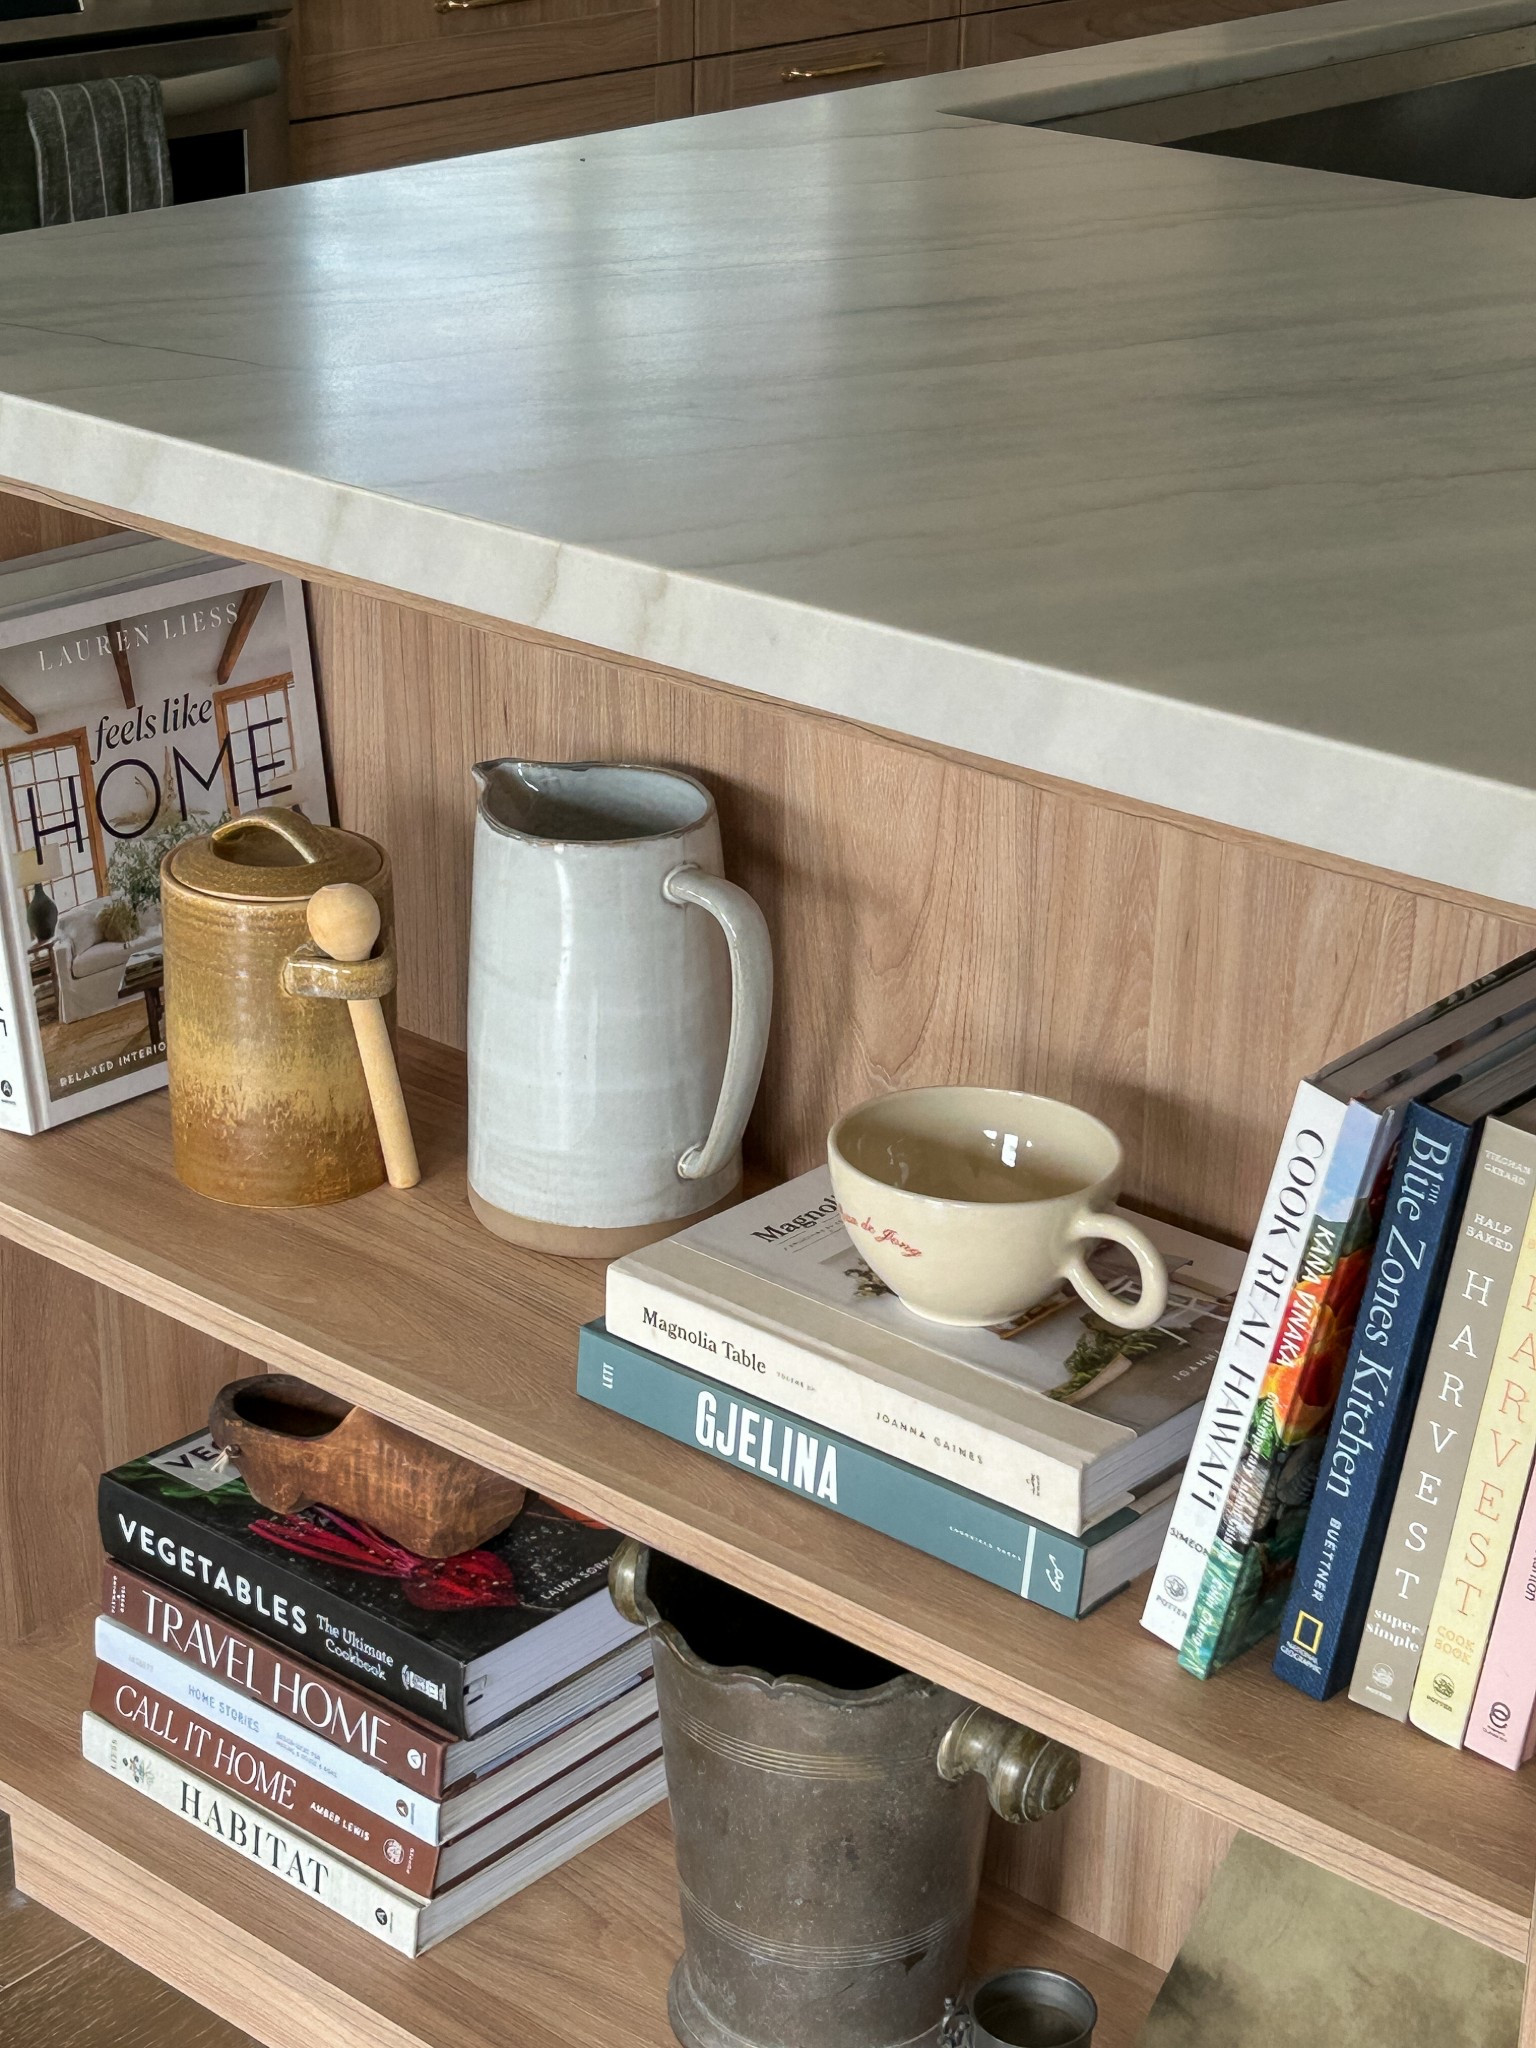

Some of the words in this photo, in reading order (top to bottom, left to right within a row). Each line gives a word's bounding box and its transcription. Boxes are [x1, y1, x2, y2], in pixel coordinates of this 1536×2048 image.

[38, 624, 150, 671] LAUREN
[163, 602, 238, 640] LIESS
[91, 705, 156, 765] feels
[162, 691, 214, 734] like
[27, 715, 293, 865] HOME
[59, 1060, 114, 1087] RELAXED
[118, 1041, 167, 1067] INTERIO
[1268, 1129, 1325, 1248] COOK
[1396, 1127, 1452, 1222] Blue
[751, 1195, 838, 1243] Magnol
[1465, 1225, 1514, 1253] BAKED
[1474, 1213, 1513, 1235] HALF
[1301, 1224, 1337, 1285] KANA
[1364, 1224, 1427, 1347] Zones
[1234, 1252, 1289, 1348] REAL
[1276, 1289, 1317, 1368] VINAKA
[642, 1306, 718, 1354] Magnolia
[721, 1340, 767, 1374] Table
[602, 1361, 615, 1390] LETT
[694, 1389, 839, 1505] GJELINA
[876, 1411, 927, 1440] JOANNA
[933, 1436, 984, 1465] GAINES
[1325, 1349, 1393, 1499] Kitchen
[1395, 1268, 1495, 1600] HARVEST
[118, 1512, 308, 1635] VEGETABLES
[540, 1576, 580, 1600] LAURA
[1312, 1517, 1342, 1601] BUETTNER
[316, 1613, 340, 1639] The
[342, 1627, 394, 1668] Ultimate
[325, 1638, 387, 1681] Cookbook
[1365, 1621, 1420, 1653] simple
[1433, 1638, 1471, 1666] BOOK
[1436, 1625, 1476, 1650] COOK
[142, 1590, 262, 1696] TRAVEL
[273, 1662, 392, 1765] HOME
[188, 1684, 215, 1709] HOME
[218, 1702, 260, 1734] STORIES
[116, 1685, 178, 1744] CALL
[184, 1721, 212, 1758] IT
[213, 1738, 297, 1811] HOME
[180, 1779, 329, 1895] HABITAT
[310, 1801, 341, 1825] AMBER
[342, 1818, 370, 1842] LEWIS
